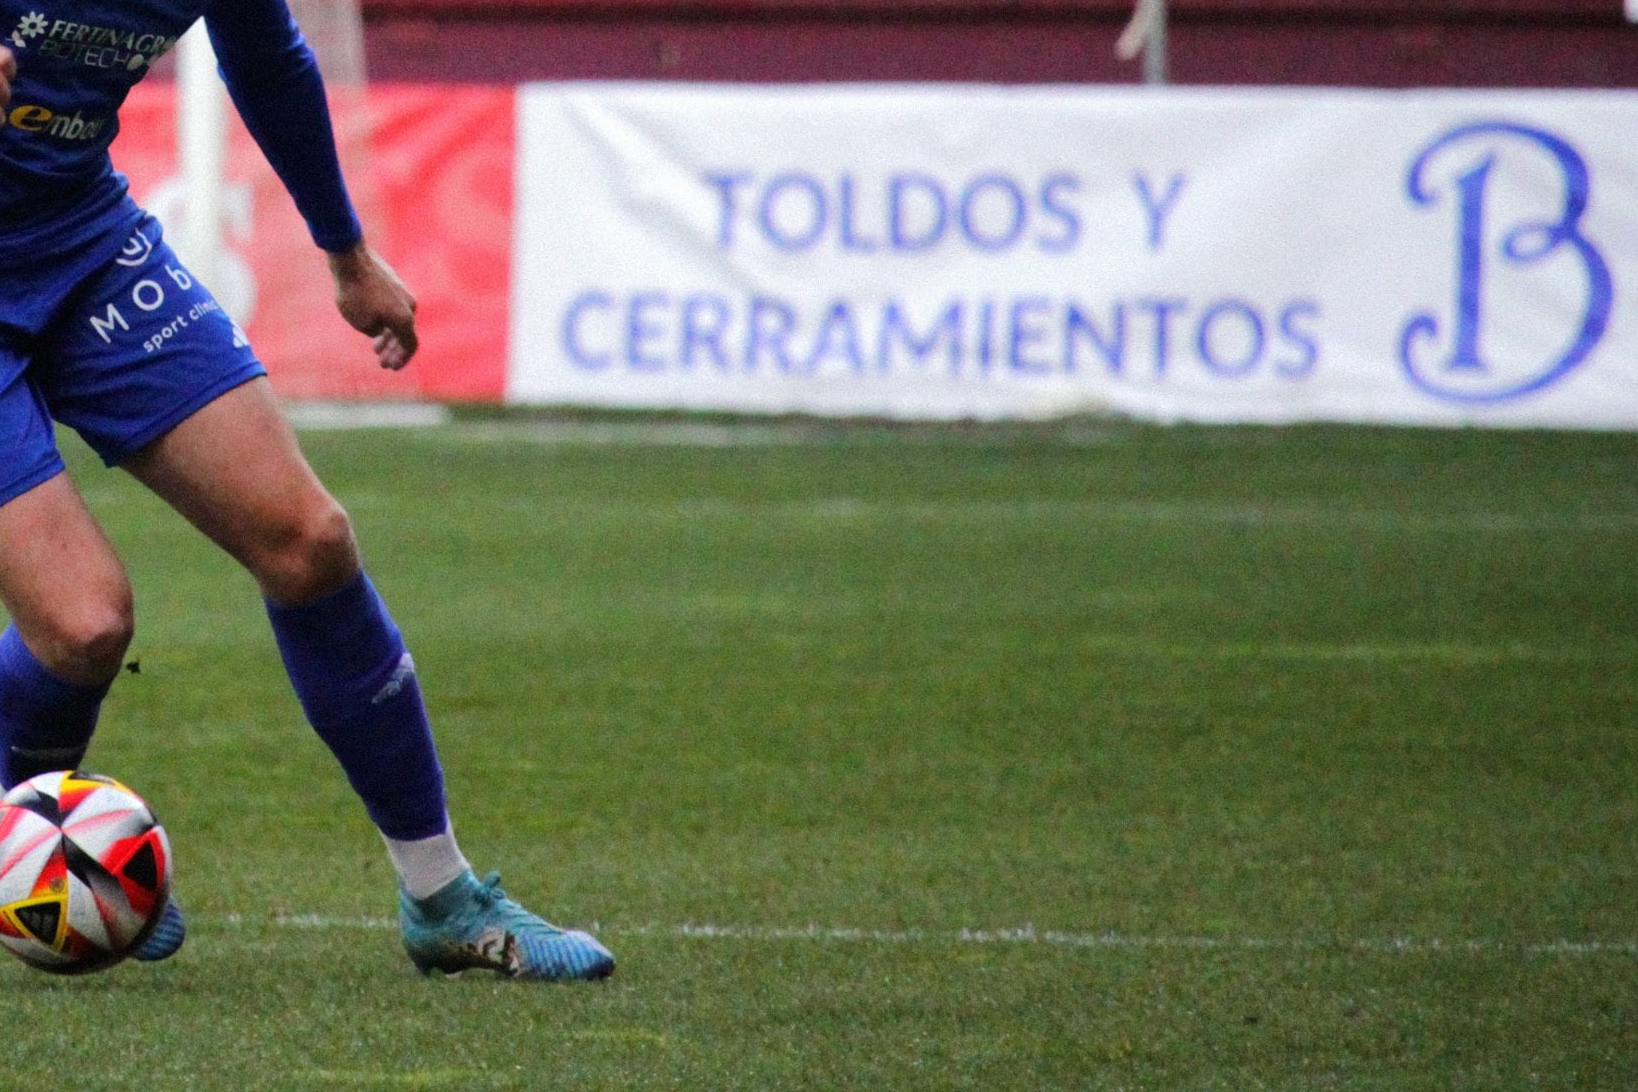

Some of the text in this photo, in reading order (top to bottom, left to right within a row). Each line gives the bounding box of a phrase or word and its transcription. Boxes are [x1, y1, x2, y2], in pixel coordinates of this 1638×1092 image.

[703, 169, 1188, 254] TOLDOS Y
[143, 315, 189, 353] sport
[560, 289, 1322, 380] CERRAMIENTOS
